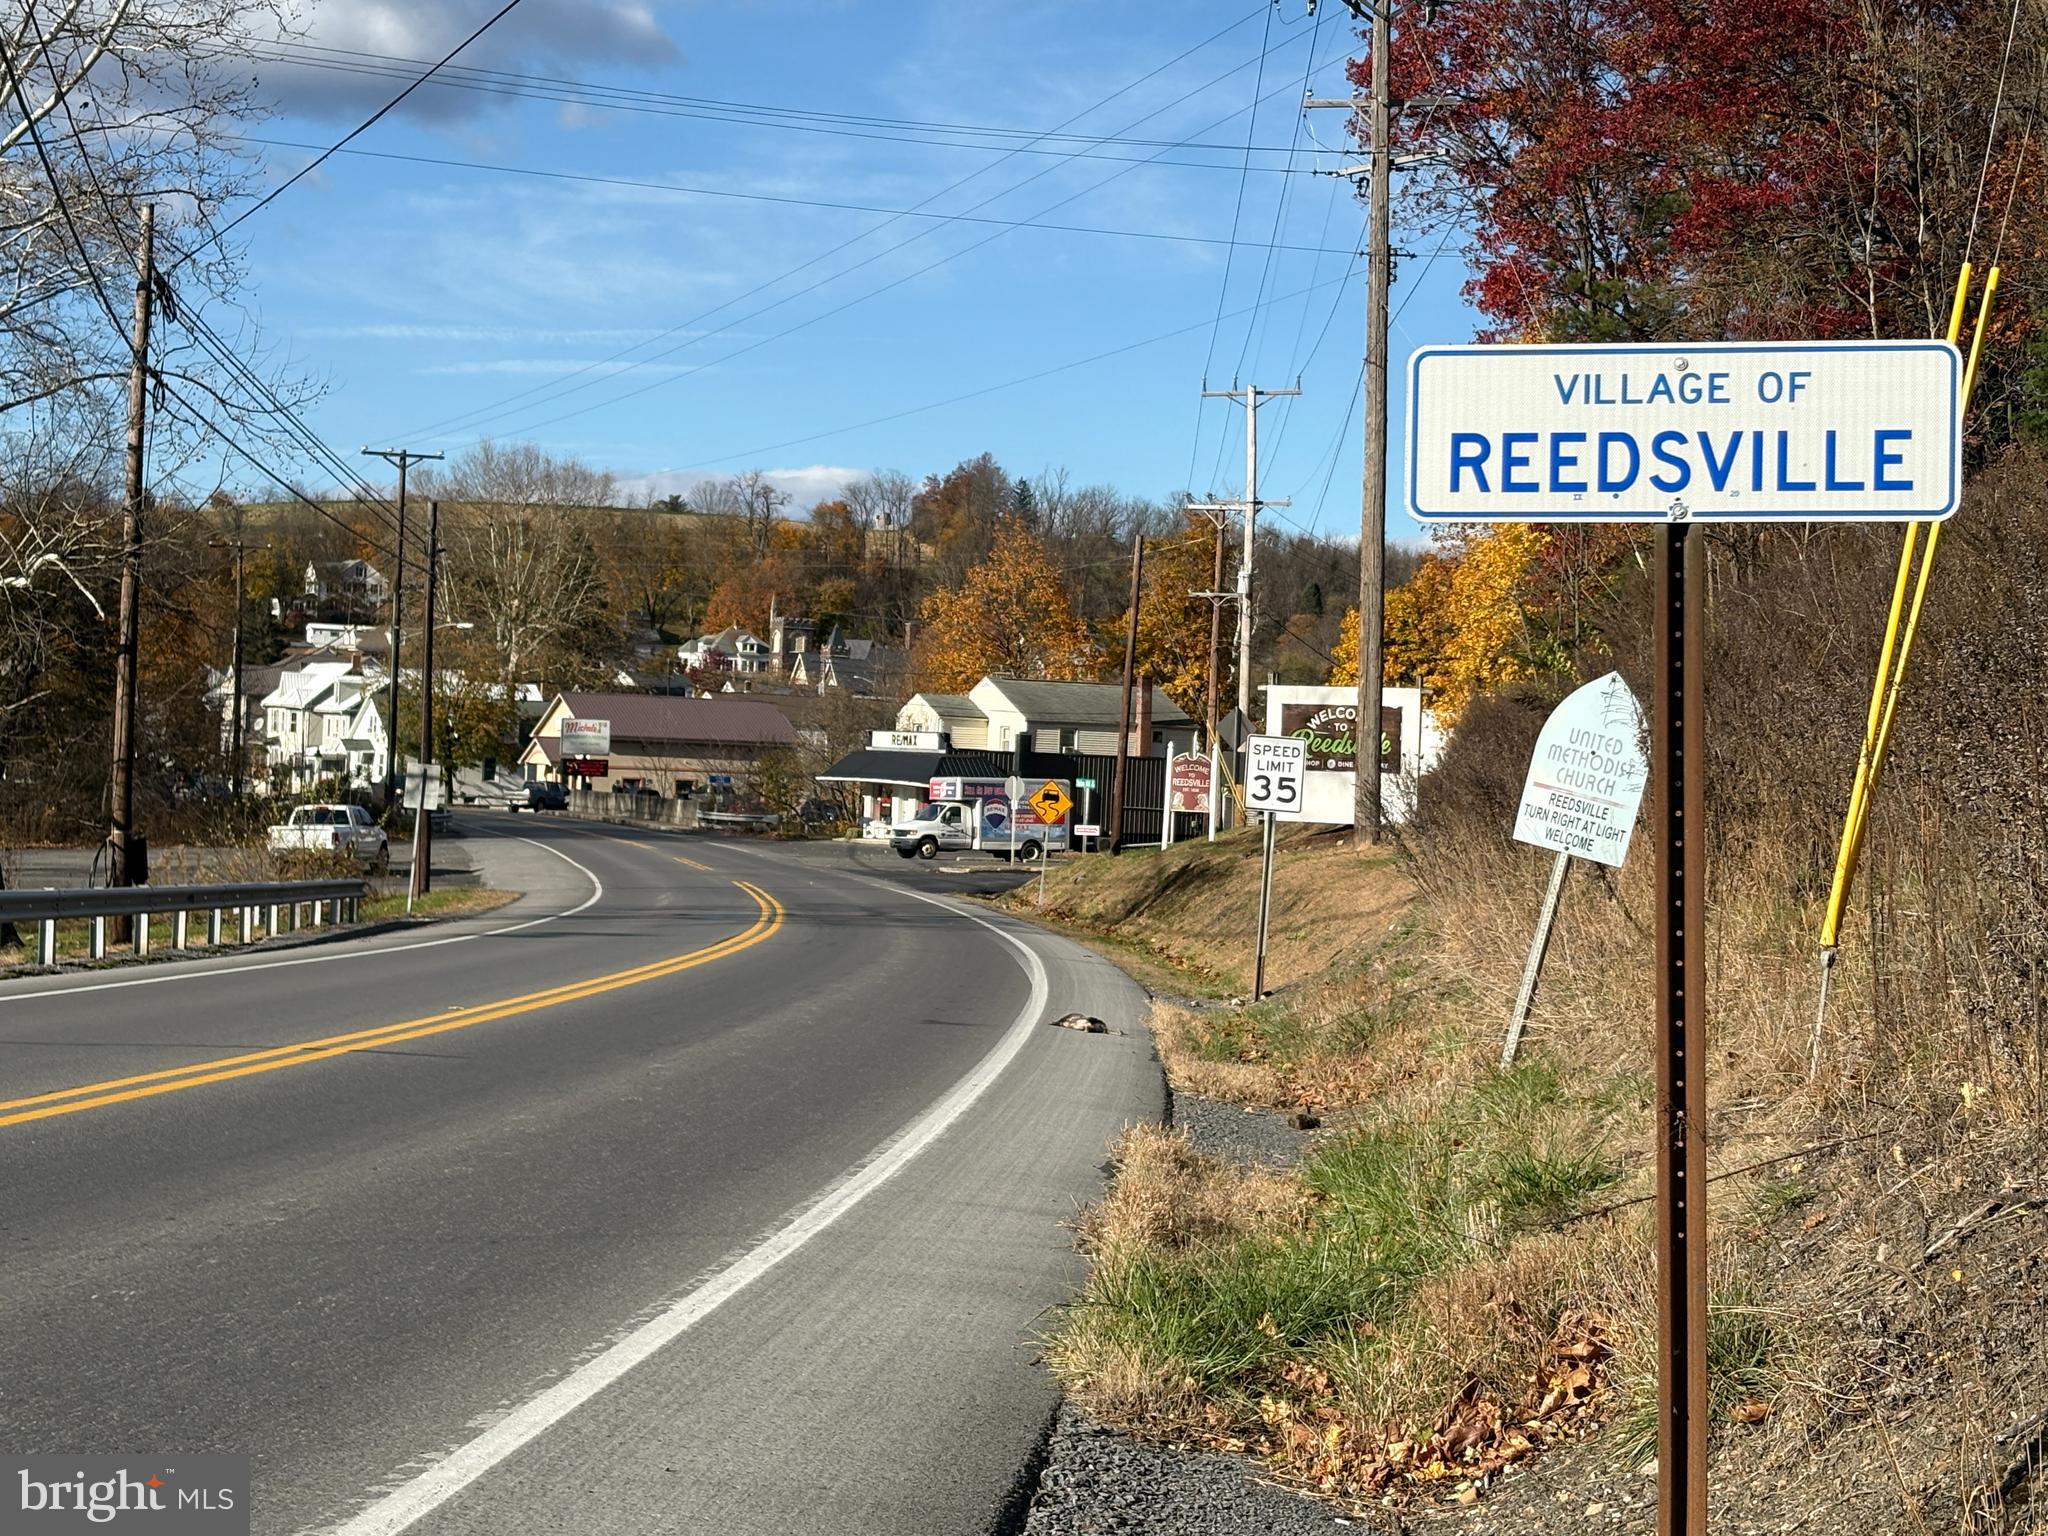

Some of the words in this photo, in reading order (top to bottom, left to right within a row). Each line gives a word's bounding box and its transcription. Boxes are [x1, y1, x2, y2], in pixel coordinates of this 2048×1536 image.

[1554, 371, 1731, 405] VILLAGE
[1757, 370, 1812, 404] OF
[1449, 429, 1914, 494] REEDSVILLE
[1306, 706, 1358, 730] WELCO
[1334, 722, 1348, 732] TO
[891, 734, 918, 746] RE/MAX
[1253, 744, 1301, 758] SPEED
[1569, 727, 1624, 756] UNITED
[1174, 764, 1209, 775] WELCOME
[1257, 760, 1294, 773] LIMIT
[1547, 743, 1636, 779] METHODIST
[1173, 778, 1210, 787] REEDSVILLE
[1251, 775, 1297, 803] 35
[1556, 767, 1616, 797] CHURCH
[1549, 793, 1610, 821] REEDSVILLE
[1525, 803, 1550, 821] TURN
[1551, 811, 1581, 829] RIGHT
[1582, 821, 1595, 833] AT
[1596, 825, 1627, 843] LIGHT
[1545, 827, 1595, 852] WELCOME
